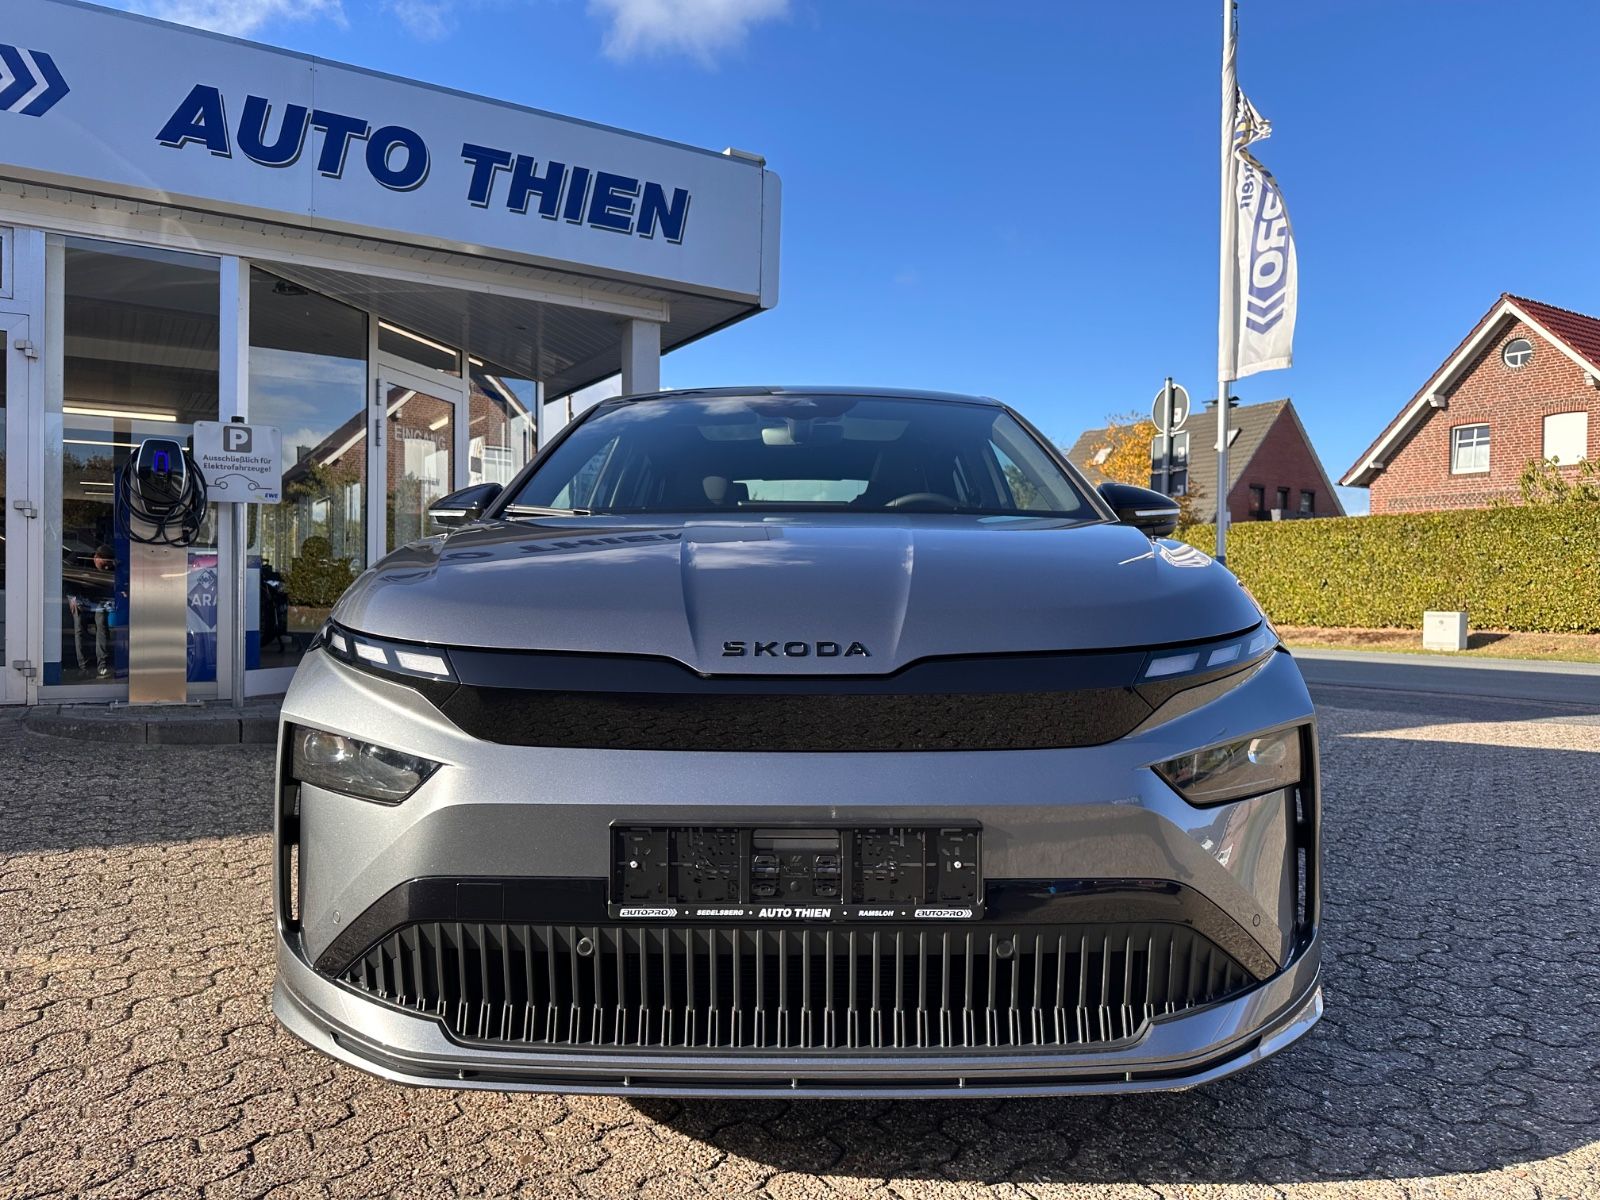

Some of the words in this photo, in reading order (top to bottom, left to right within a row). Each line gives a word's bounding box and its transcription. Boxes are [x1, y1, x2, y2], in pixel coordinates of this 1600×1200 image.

[155, 83, 430, 193] AUTO
[461, 142, 691, 245] THIEN
[229, 428, 249, 451] P
[394, 422, 446, 450] EINGANG
[203, 454, 259, 464] Ausschließlich
[260, 456, 272, 465] für
[203, 462, 272, 474] Elektrofahrzeuge!
[722, 641, 872, 657] SKODA
[758, 908, 794, 918] AUTO
[794, 908, 832, 918] THIEN
